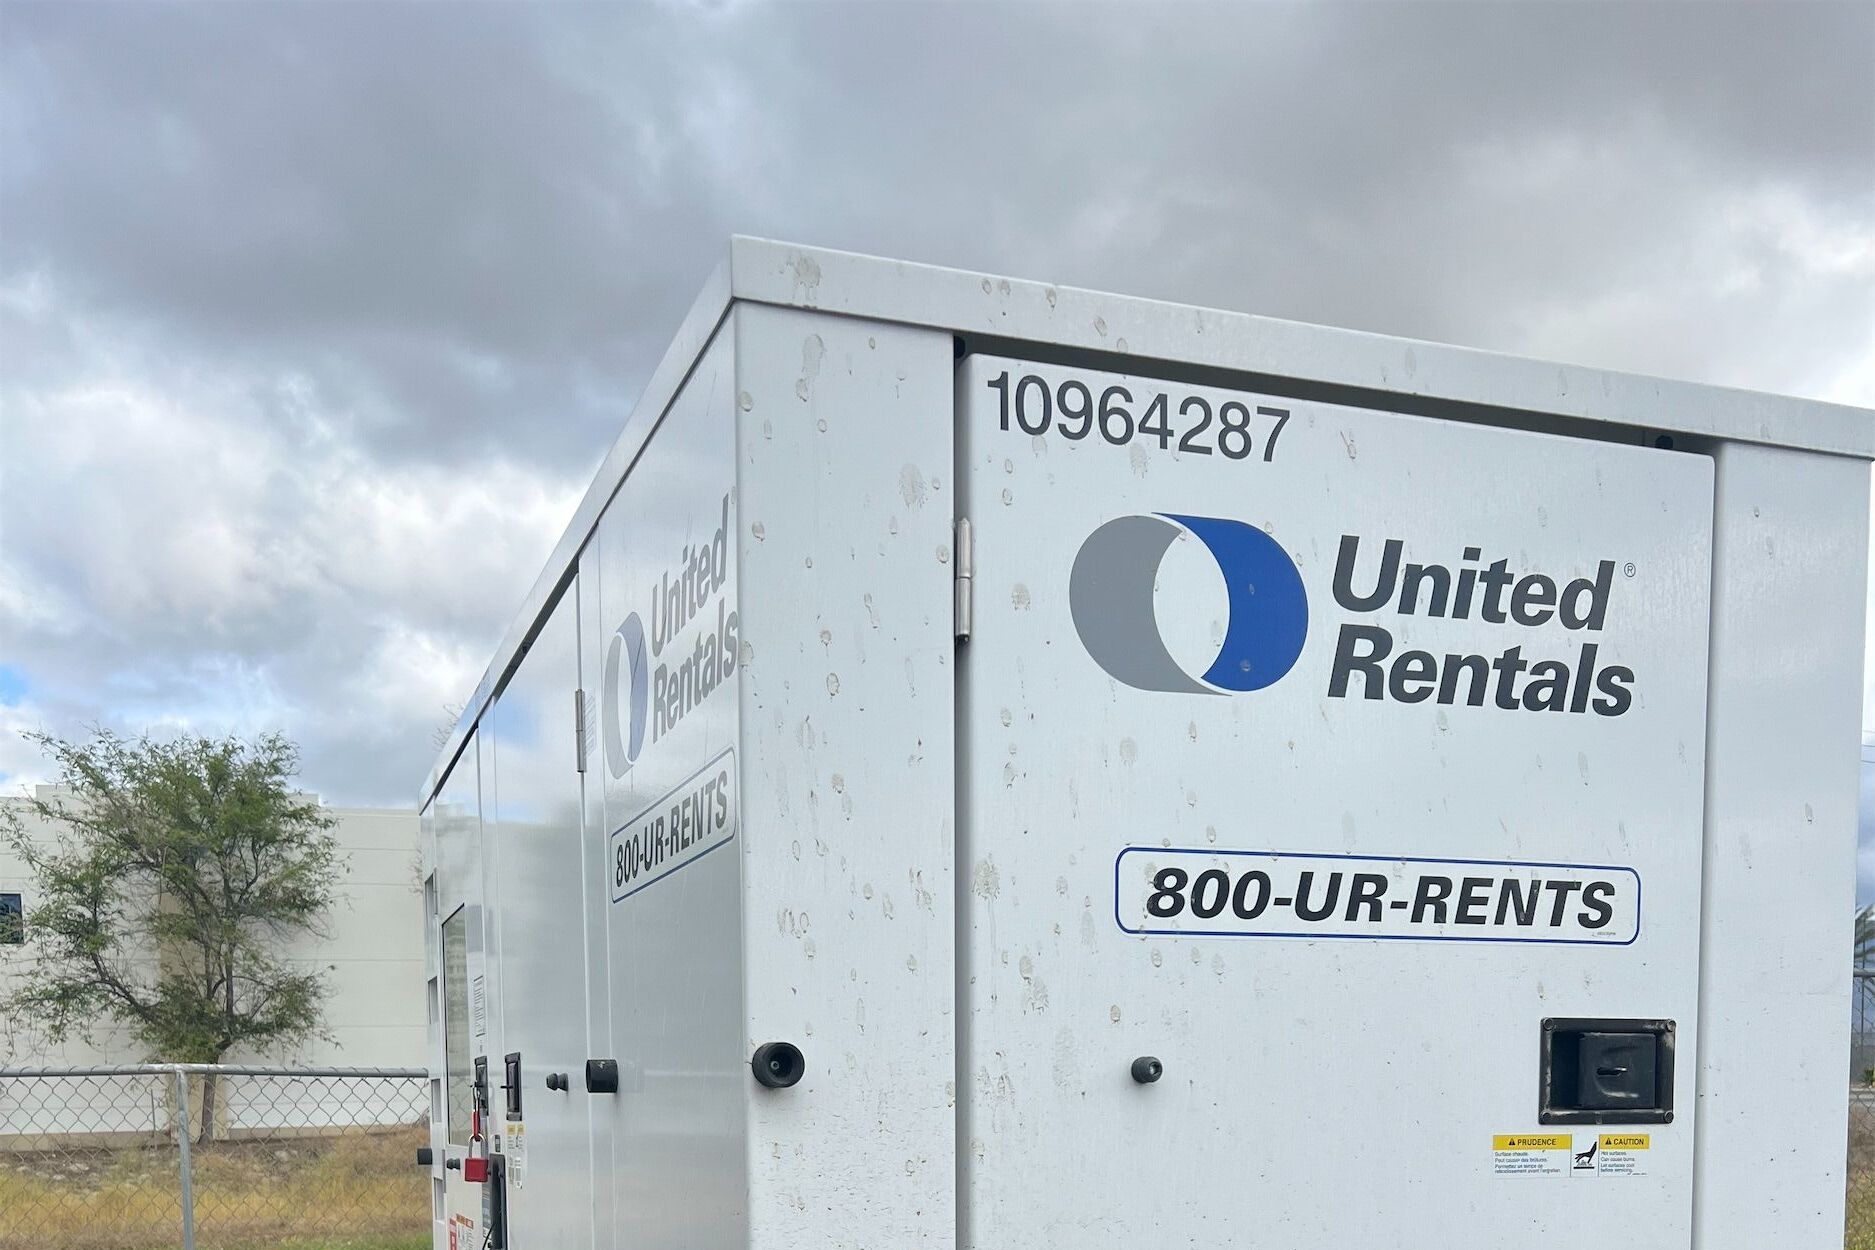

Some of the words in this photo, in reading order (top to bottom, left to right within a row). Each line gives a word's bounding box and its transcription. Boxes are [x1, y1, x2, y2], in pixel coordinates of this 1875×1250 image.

[987, 371, 1291, 463] 10964287
[652, 492, 729, 658] United
[1331, 535, 1615, 631] United
[653, 597, 738, 745] Rentals
[1326, 623, 1635, 717] Rentals
[616, 770, 728, 888] 800-UR-RENTS
[1147, 867, 1617, 930] 800-UR-RENTS
[1517, 1138, 1557, 1146] PRUDENCE
[1613, 1138, 1645, 1146] CAUTION
